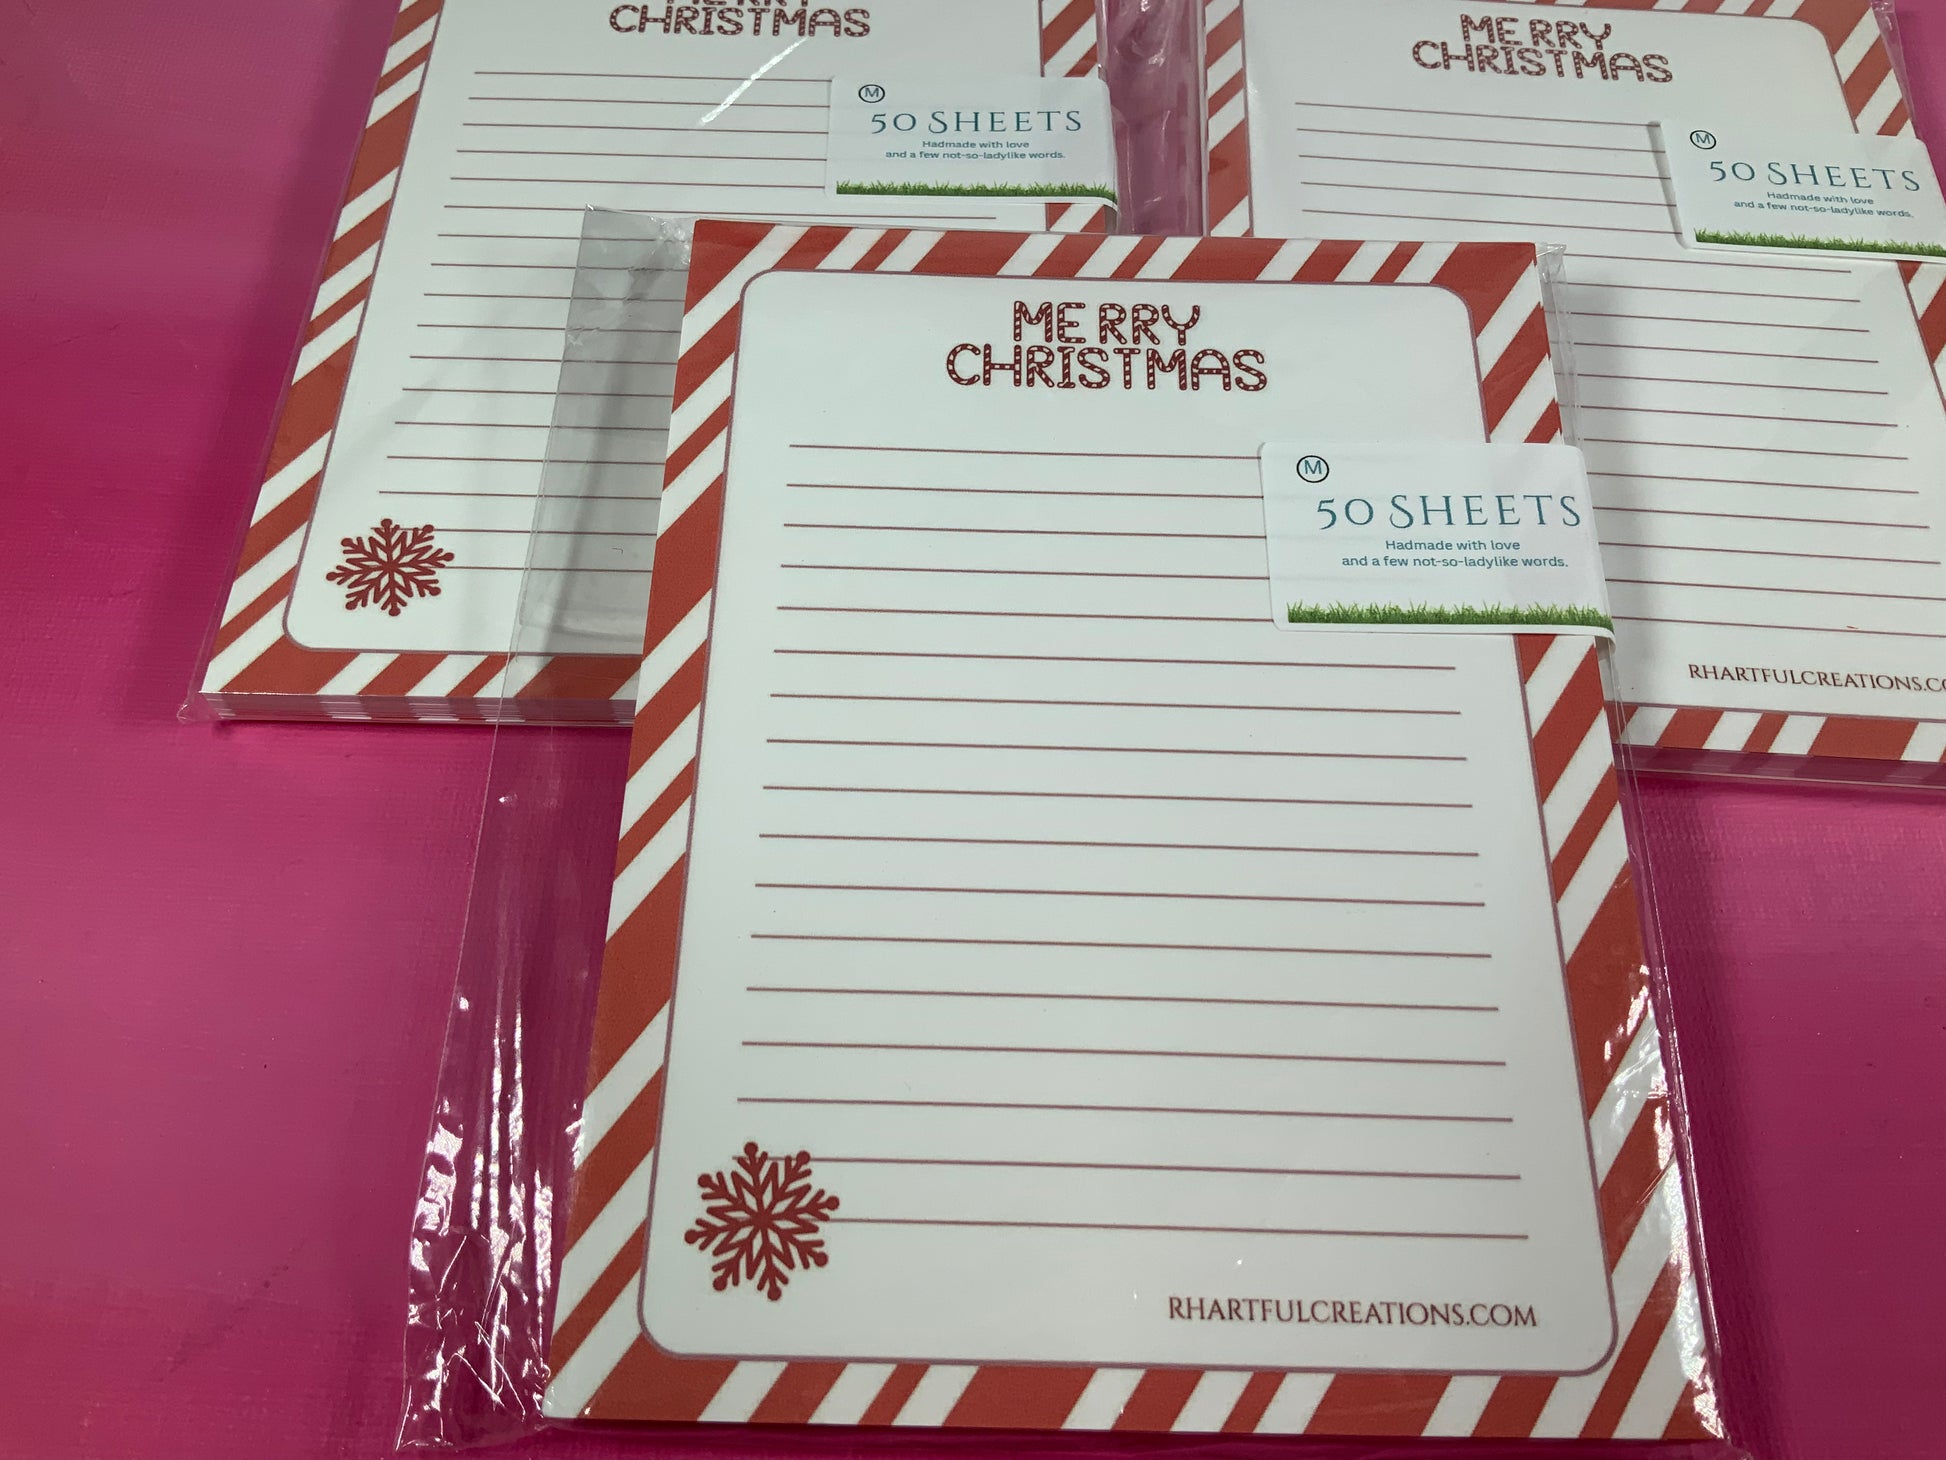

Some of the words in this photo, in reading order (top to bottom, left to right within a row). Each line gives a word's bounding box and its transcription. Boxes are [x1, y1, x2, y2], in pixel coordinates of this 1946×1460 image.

[608, 4, 871, 37] CHRISTMAS
[1459, 13, 1612, 51] MERRY
[1411, 39, 1674, 83] CHRISTMAS
[871, 112, 917, 135] 50
[885, 150, 907, 159] and
[909, 151, 917, 159] a
[919, 150, 940, 159] few
[942, 150, 1027, 160] not-so-ladylike
[1028, 151, 1066, 159] words.
[922, 140, 977, 149] Hadmade
[978, 140, 1003, 149] with
[1006, 140, 1030, 149] love
[1709, 160, 1756, 182] 50
[1734, 200, 1755, 209] and
[1766, 201, 1788, 210] few
[1790, 203, 1874, 216] not-so-ladylike
[1876, 209, 1915, 218] words.
[1767, 191, 1821, 202] Hadmade
[1823, 195, 1849, 204] with
[1850, 196, 1874, 205] love
[1013, 300, 1201, 345] MERRY
[946, 343, 1268, 391] CHRISTMAS
[1316, 498, 1375, 530] 50
[1385, 539, 1454, 551] Hadmade
[1455, 539, 1488, 551] with
[1490, 539, 1521, 551] love
[1341, 555, 1368, 567] and
[1371, 558, 1381, 567] a
[1383, 555, 1410, 567] few
[1412, 555, 1519, 570] not-so-ladylike
[1521, 556, 1569, 568] words.
[1688, 663, 1946, 693] RHARTFULCREATIONS.C
[1168, 1296, 1538, 1328] RHARTFULCREATIONS.COM
